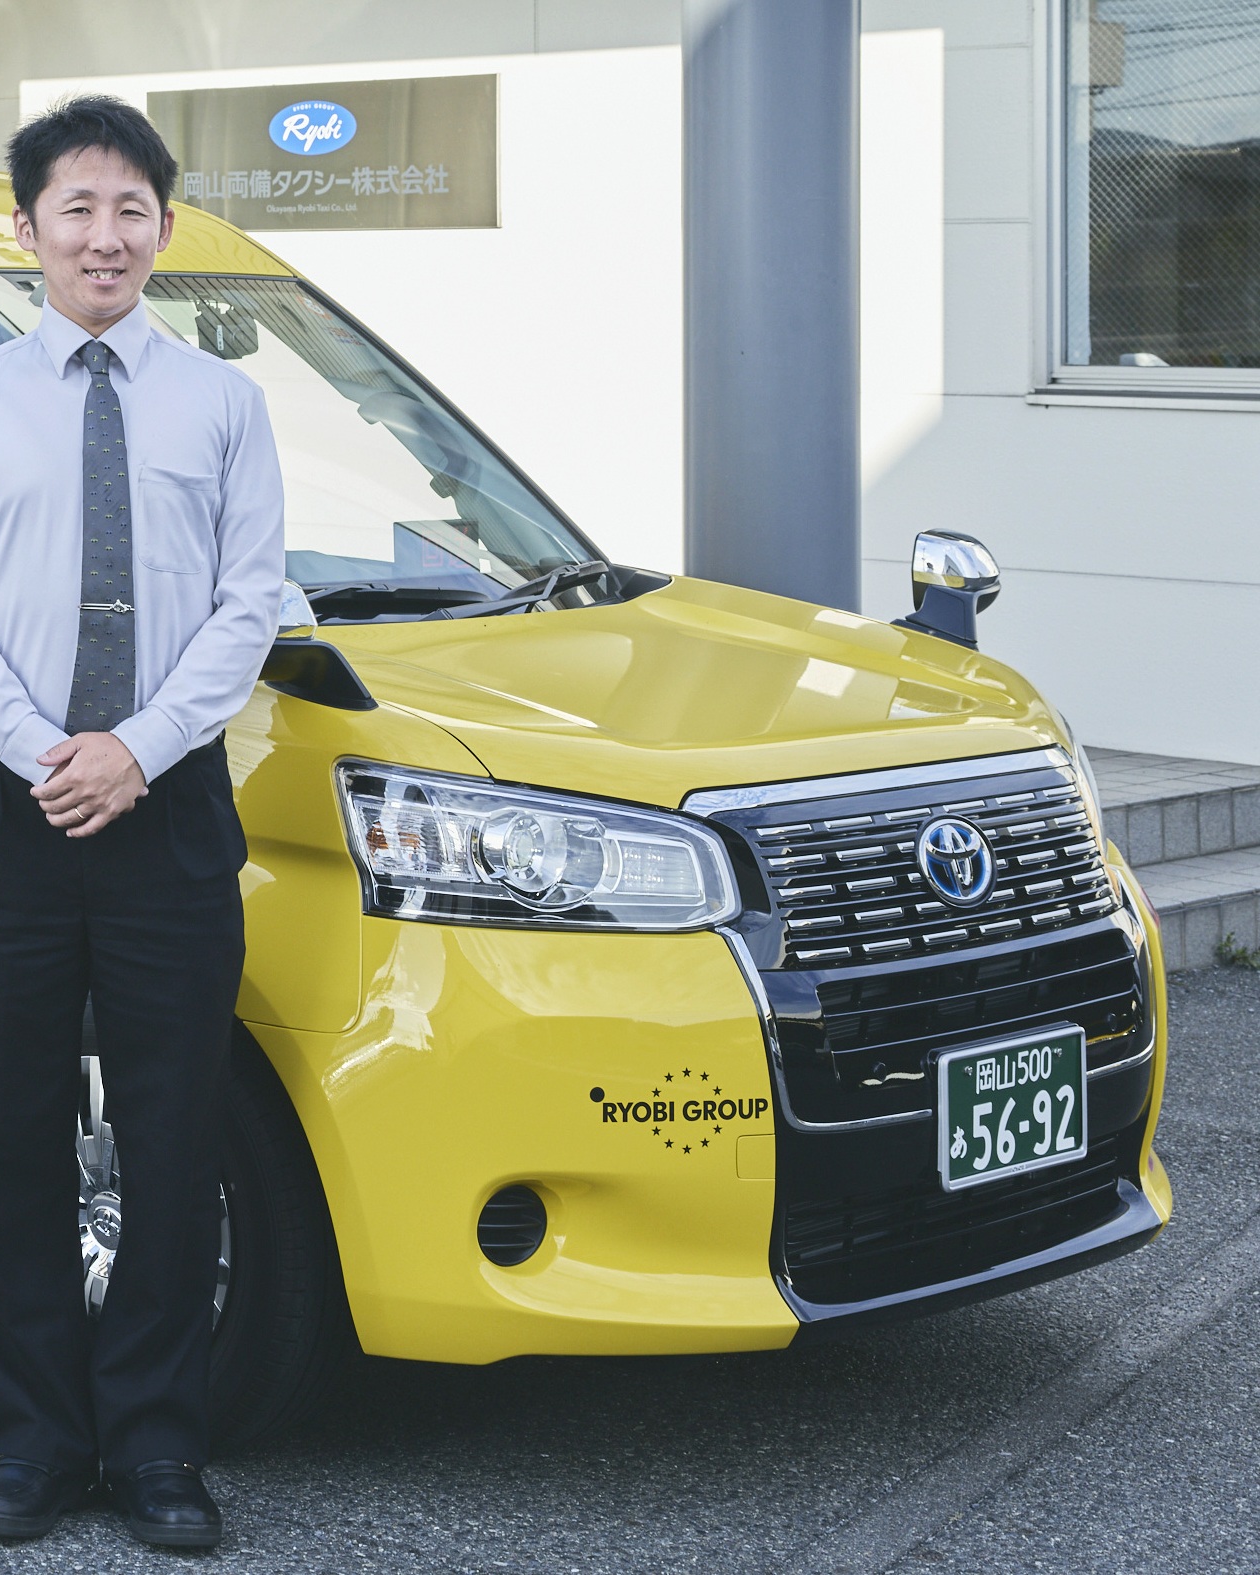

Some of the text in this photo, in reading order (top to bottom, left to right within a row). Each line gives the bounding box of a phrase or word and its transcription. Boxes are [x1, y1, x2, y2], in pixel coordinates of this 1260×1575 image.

[282, 113, 343, 152] Ryobi
[184, 164, 450, 200] 岡山両備タクシー株式会社
[602, 1098, 769, 1123] RYOBI GROUP
[950, 1084, 1075, 1171] あ 56-92
